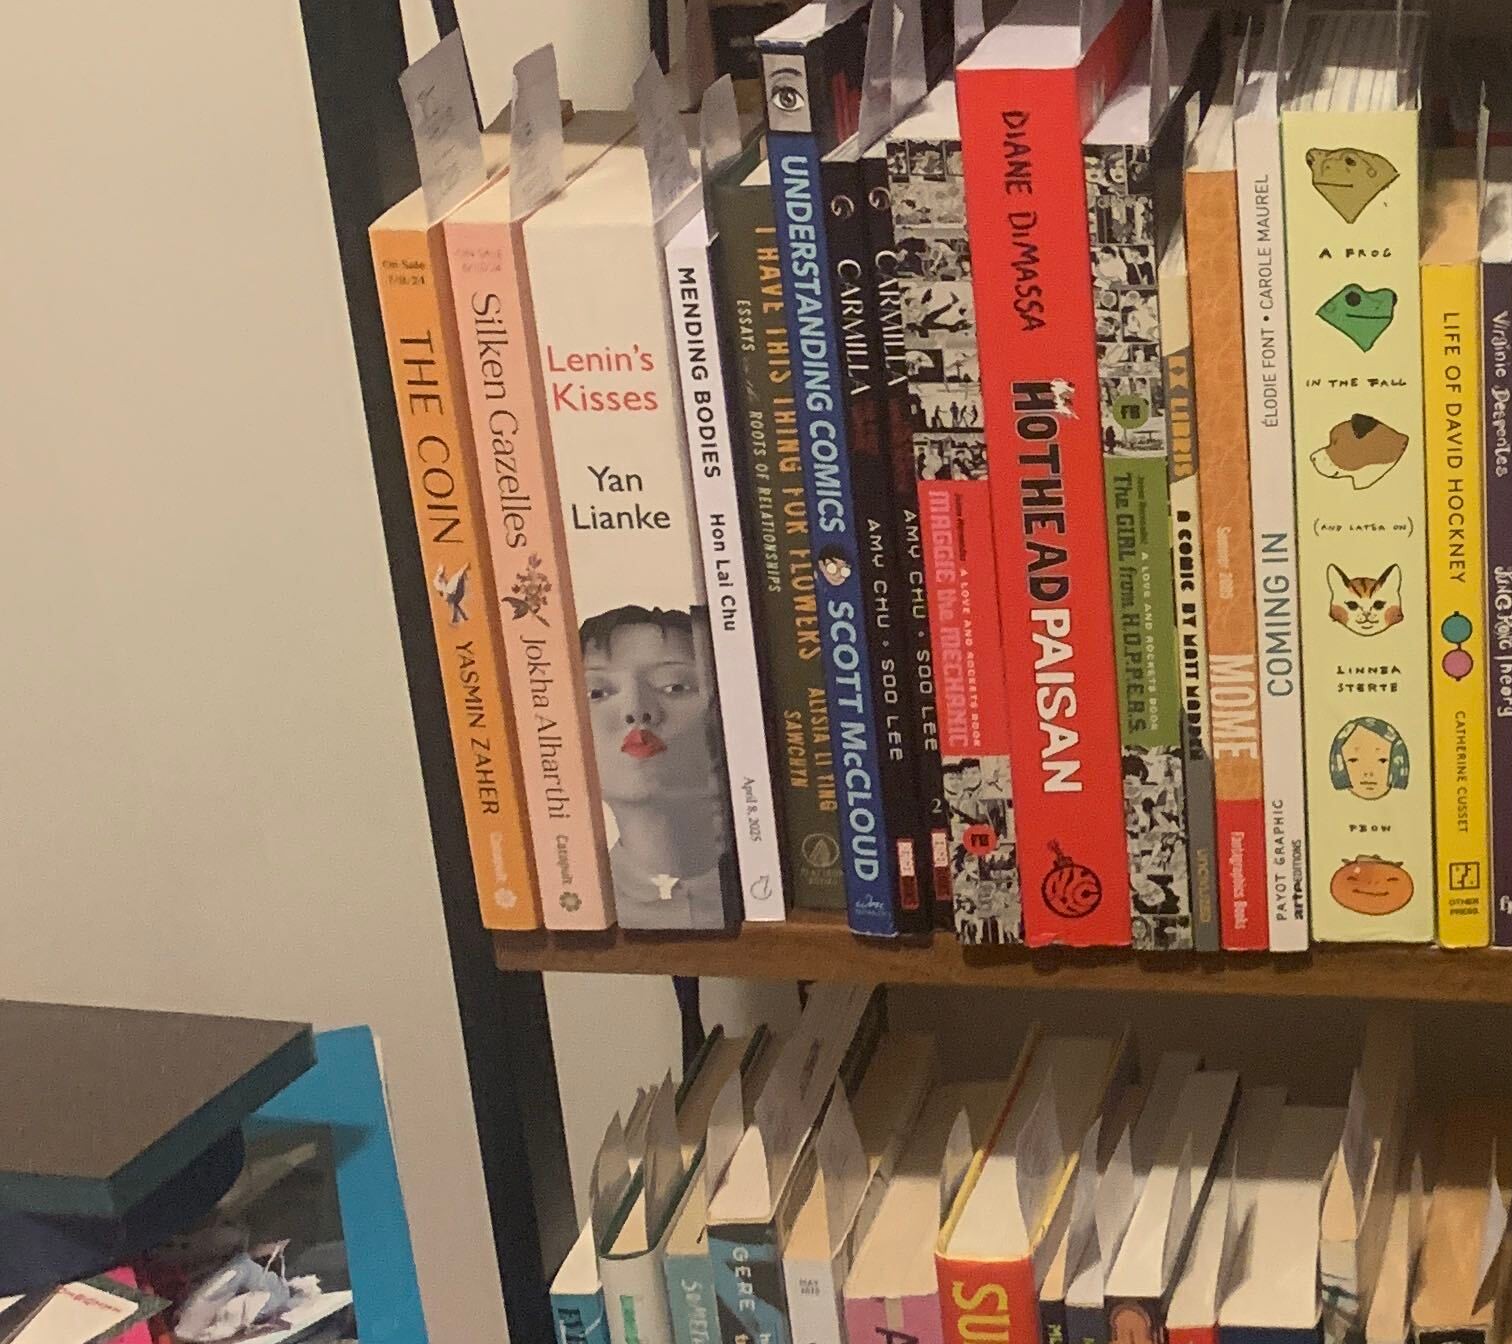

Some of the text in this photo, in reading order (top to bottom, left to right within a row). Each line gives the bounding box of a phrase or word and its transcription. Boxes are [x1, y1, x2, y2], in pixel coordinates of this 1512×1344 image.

[546, 344, 656, 374] Lenin's
[551, 382, 659, 414] Kisses
[676, 265, 737, 632] MENDING BODIES Hon Lai Chu
[1443, 311, 1467, 585] LIFE OF DAVID HOCKNEY
[399, 328, 501, 818] THE COIN YASMIN ZAHER
[469, 289, 572, 822] Silken Gazelles Jokha Alharthi
[573, 503, 672, 532] Lianke
[587, 465, 644, 496] Yan
[783, 155, 879, 883] UNDERSTANDING COMICS SCOTT McCLOUD
[1008, 378, 1084, 794] HOTHEAD PAISAN
[1209, 654, 1259, 761] MOME
[1261, 531, 1294, 698] COMING IN
